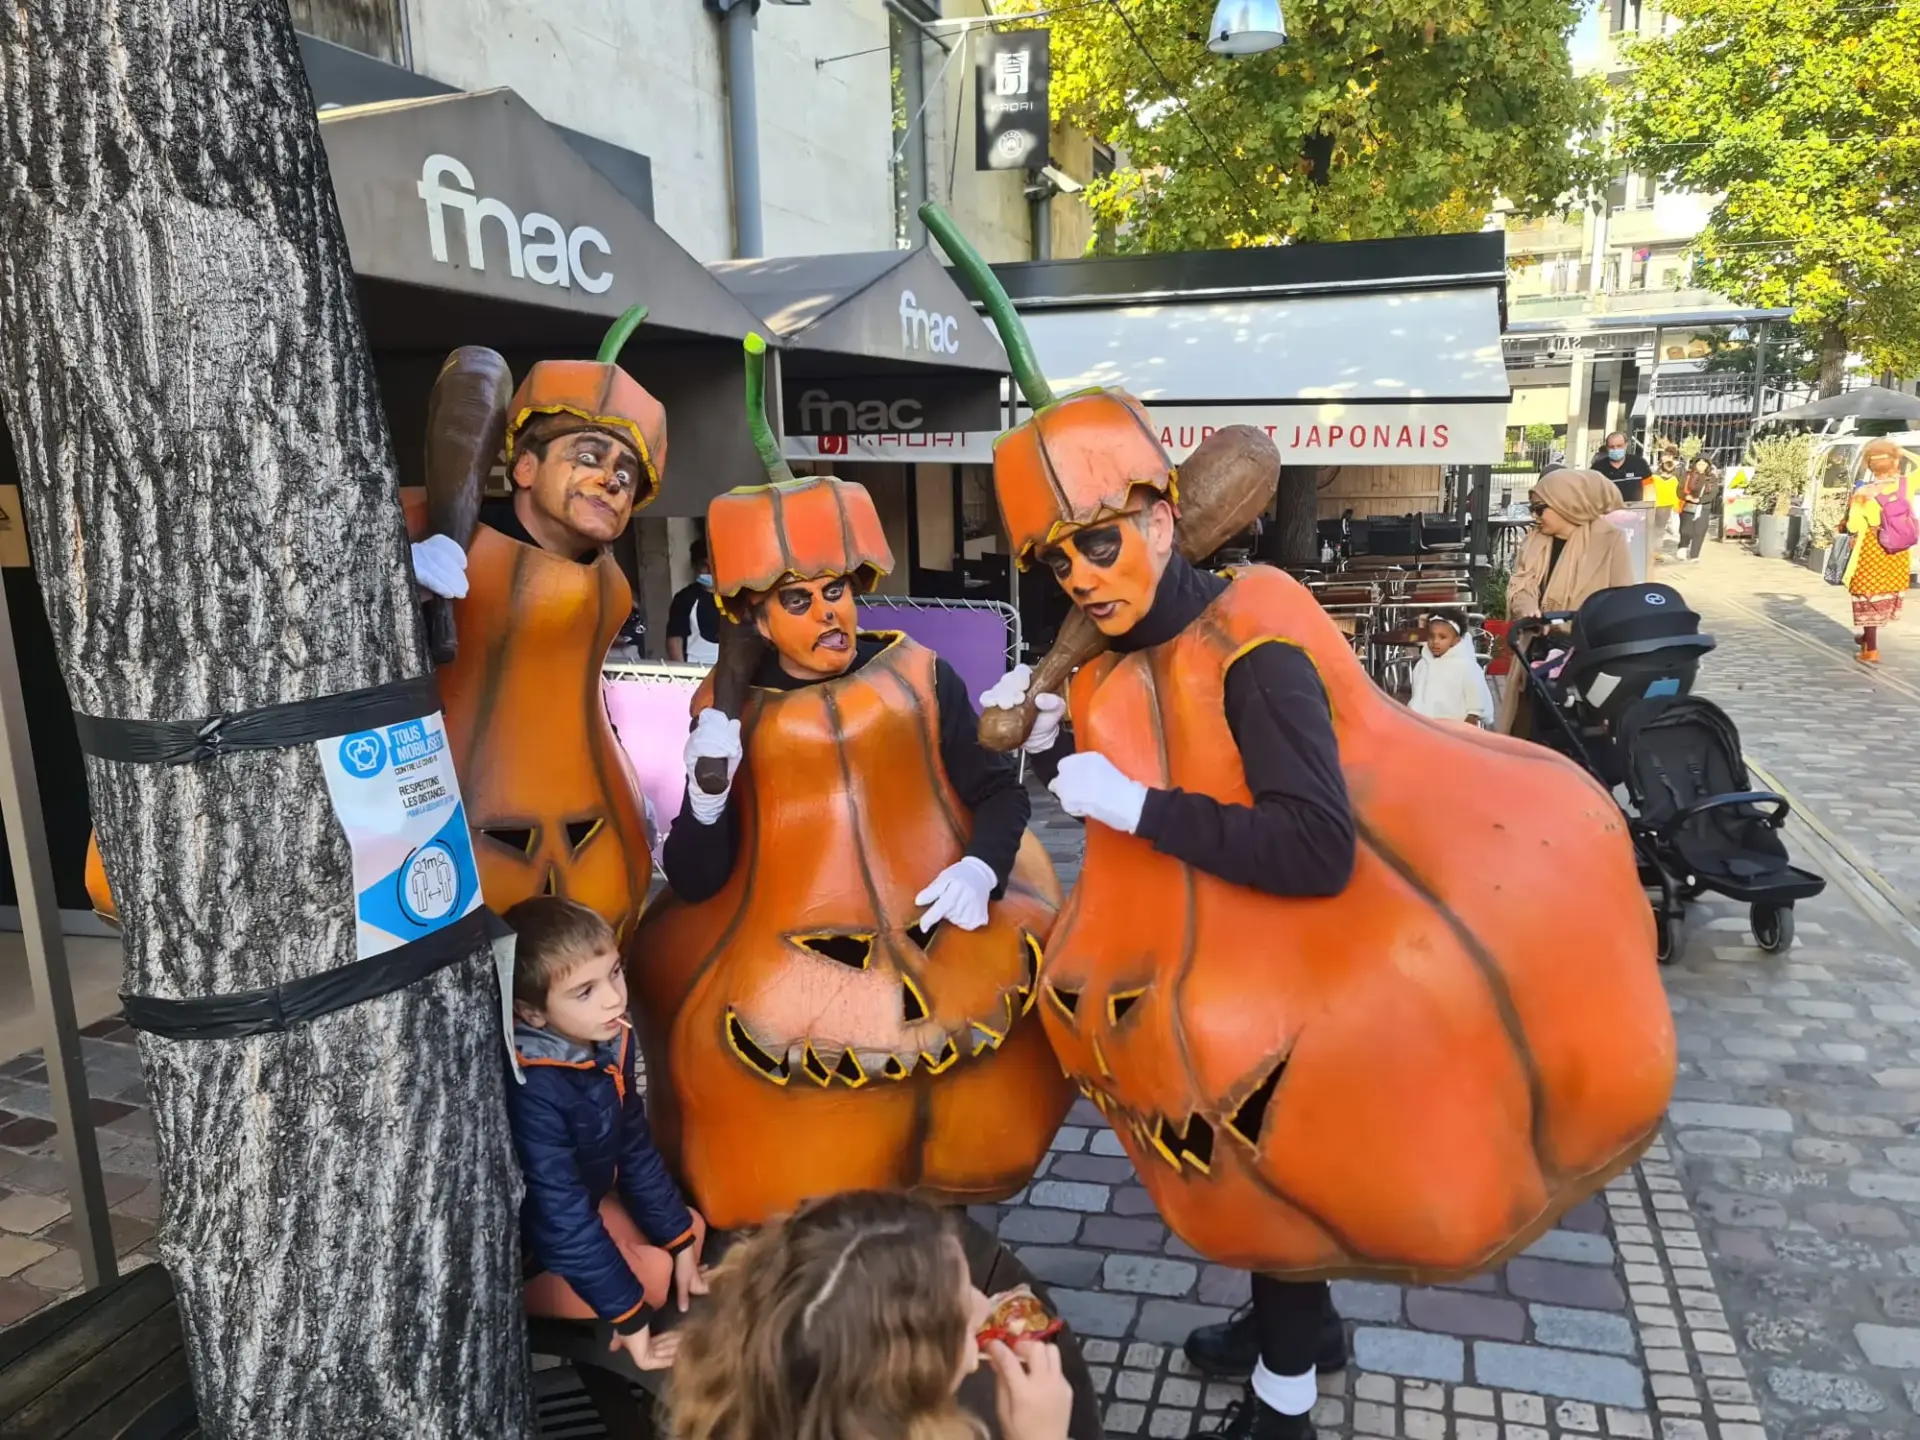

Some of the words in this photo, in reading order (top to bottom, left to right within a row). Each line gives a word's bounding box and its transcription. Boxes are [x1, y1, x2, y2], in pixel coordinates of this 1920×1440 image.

[417, 154, 614, 294] fnac
[899, 290, 959, 354] fnac
[798, 389, 923, 431] fnac
[1290, 424, 1449, 448] JAPONAIS
[391, 725, 421, 745] TOUS
[394, 762, 416, 775] CONTRE
[399, 776, 440, 796] RESPECTONS
[402, 796, 418, 808] LES
[421, 857, 437, 870] 1m
